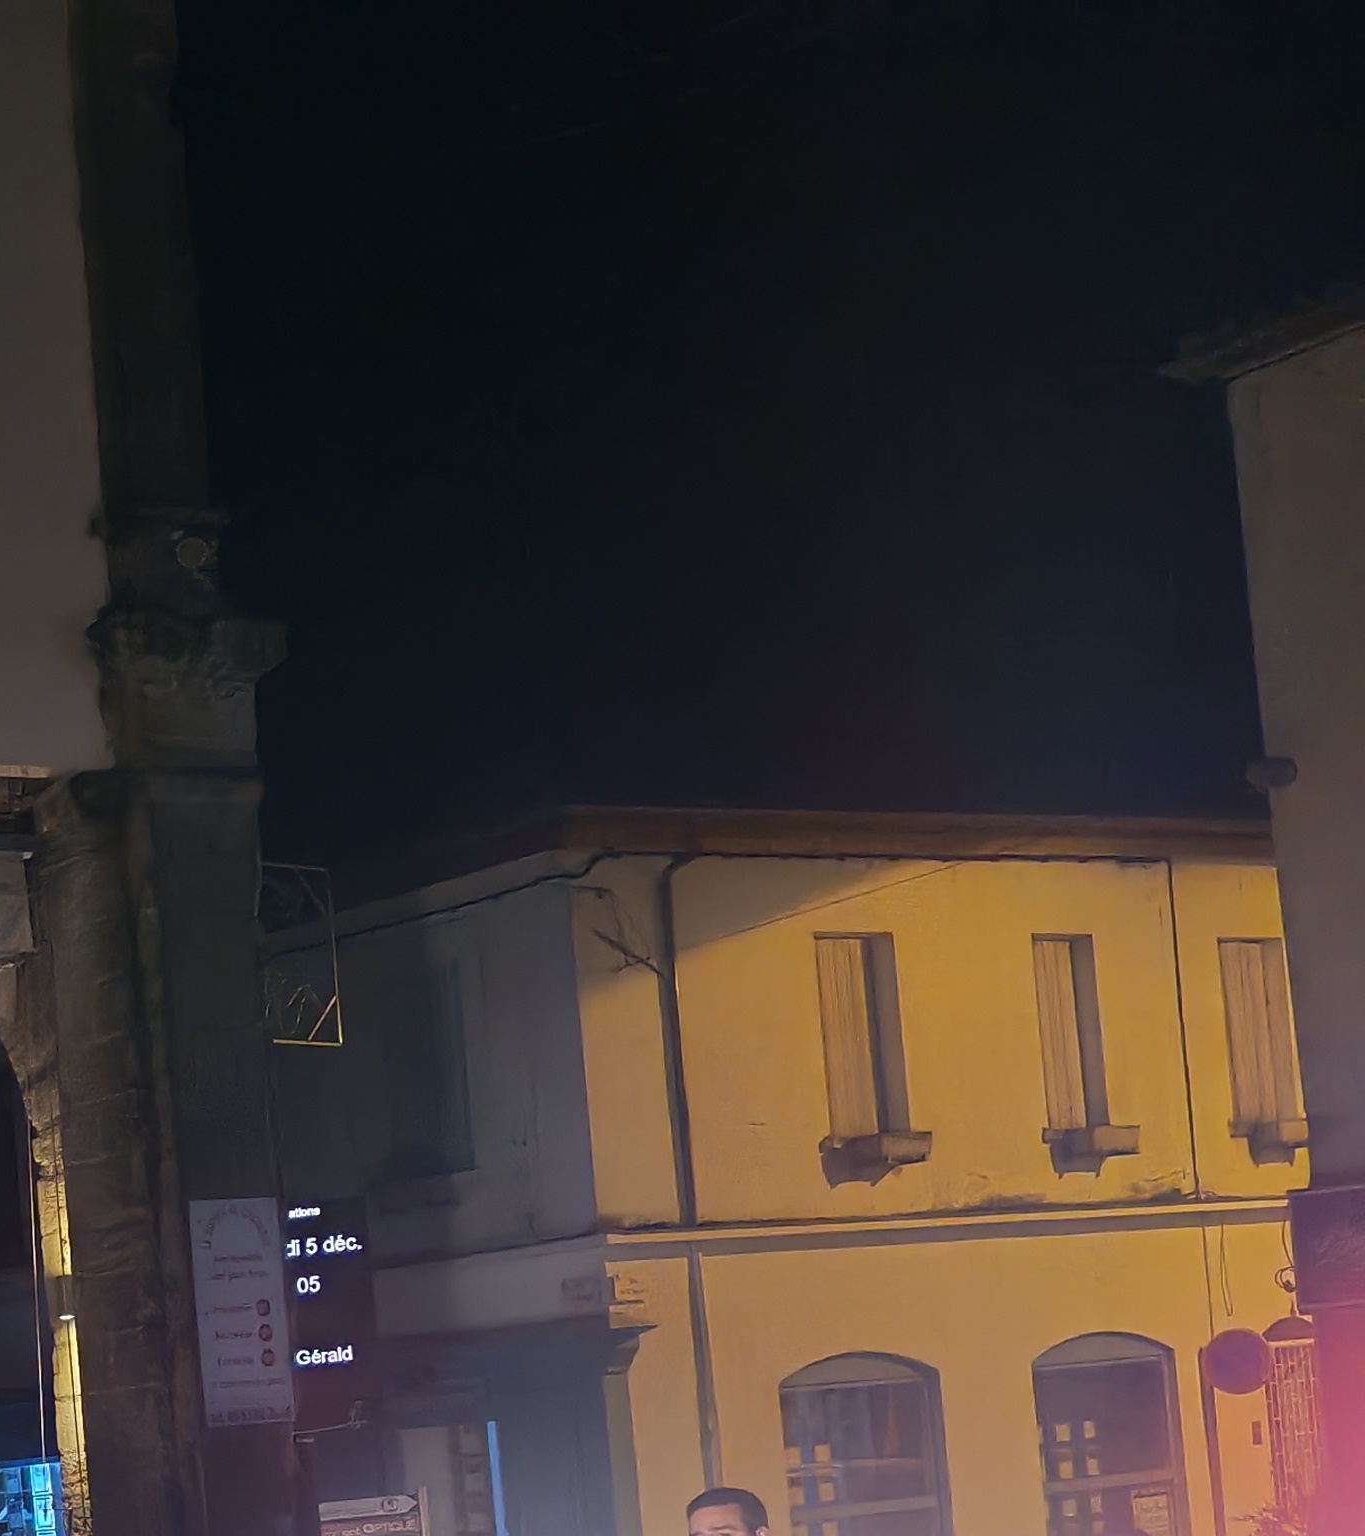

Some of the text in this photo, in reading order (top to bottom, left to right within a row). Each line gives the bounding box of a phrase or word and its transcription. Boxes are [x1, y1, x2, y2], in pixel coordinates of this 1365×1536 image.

[305, 1237, 318, 1255] 5
[322, 1234, 363, 1253] déc.
[296, 1275, 321, 1293] 05
[295, 1345, 354, 1365] Gérald
